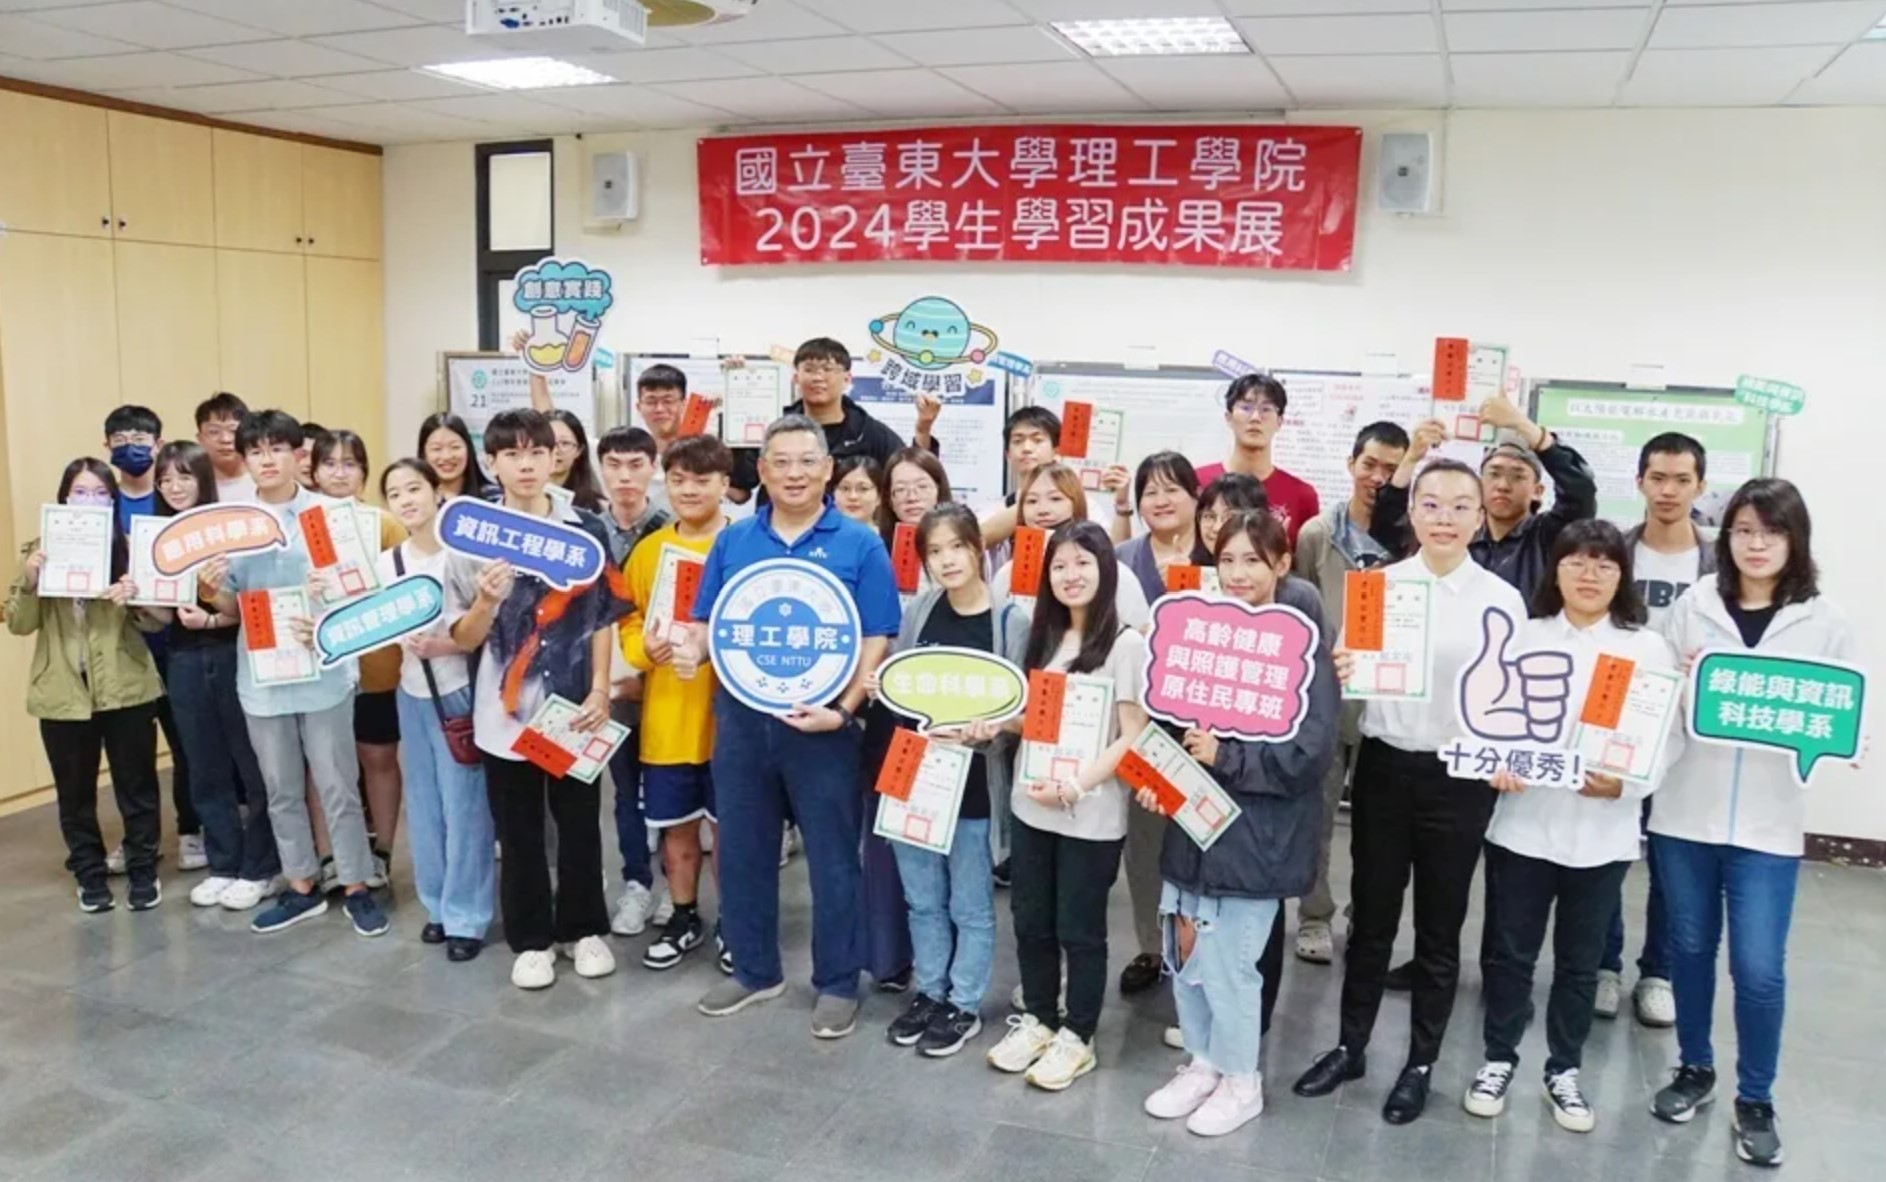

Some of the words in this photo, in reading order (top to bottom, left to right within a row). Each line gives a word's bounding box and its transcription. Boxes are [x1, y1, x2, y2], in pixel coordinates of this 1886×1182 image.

[735, 136, 1307, 195] 國立臺東大學理工學院
[756, 197, 1284, 256] 2024學生學習成果展
[523, 280, 603, 300] 創意實踐
[881, 358, 963, 393] 跨域學習
[161, 517, 270, 562] 應用科學系
[453, 515, 587, 568] 資訊工程學系
[325, 585, 437, 647] 資訊管理學系
[732, 624, 838, 650] 理工學院
[1183, 618, 1284, 657] 高齡健康
[757, 654, 777, 666] CSE
[1166, 644, 1290, 690] 與照護管理
[891, 671, 1010, 698] 生命科學系
[1160, 674, 1284, 719] 原住民專班
[1708, 668, 1854, 711] 綠能與資訊
[1718, 701, 1834, 739] 科技學系
